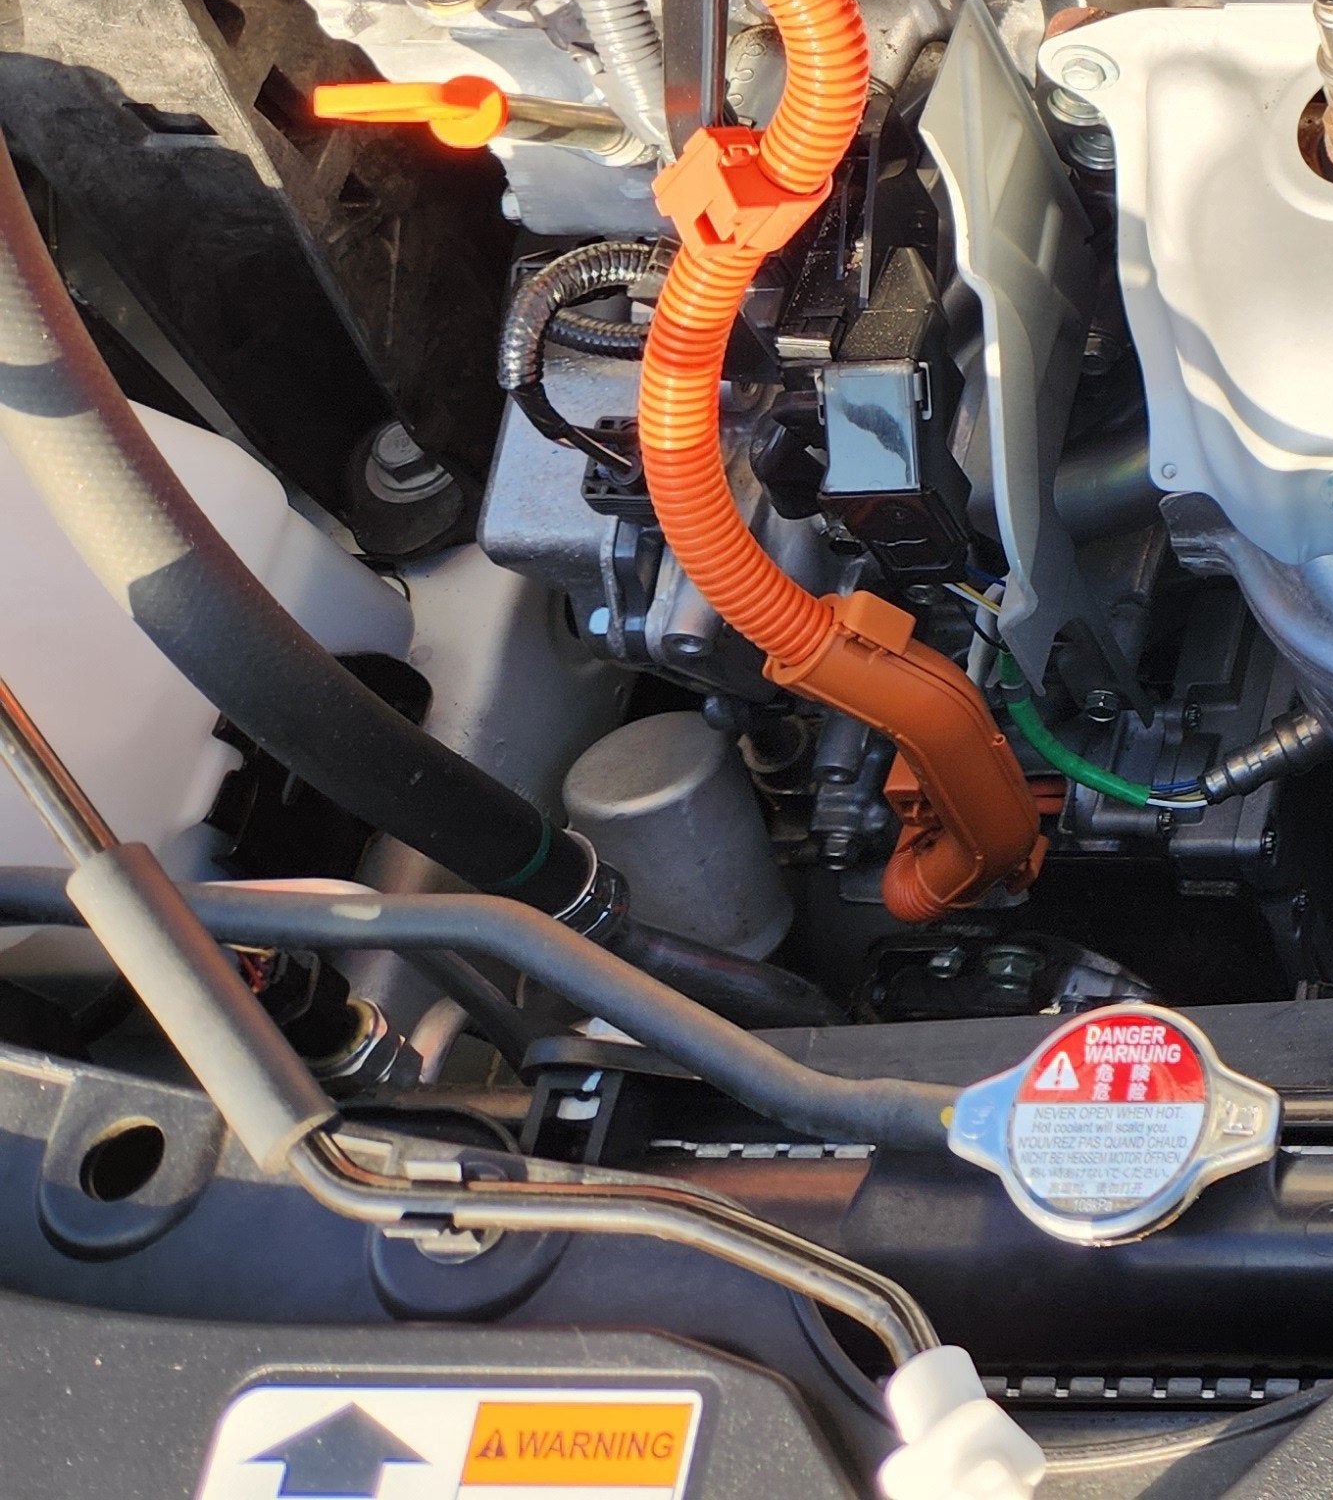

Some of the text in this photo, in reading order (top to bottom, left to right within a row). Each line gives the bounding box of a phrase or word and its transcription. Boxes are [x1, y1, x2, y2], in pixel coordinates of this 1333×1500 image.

[1085, 1025, 1167, 1045] DANGER
[1084, 1043, 1182, 1064] WARNUNG
[1034, 1106, 1184, 1120] NEVER OPEN WHEN HOT.
[517, 1428, 675, 1463] WARNING
